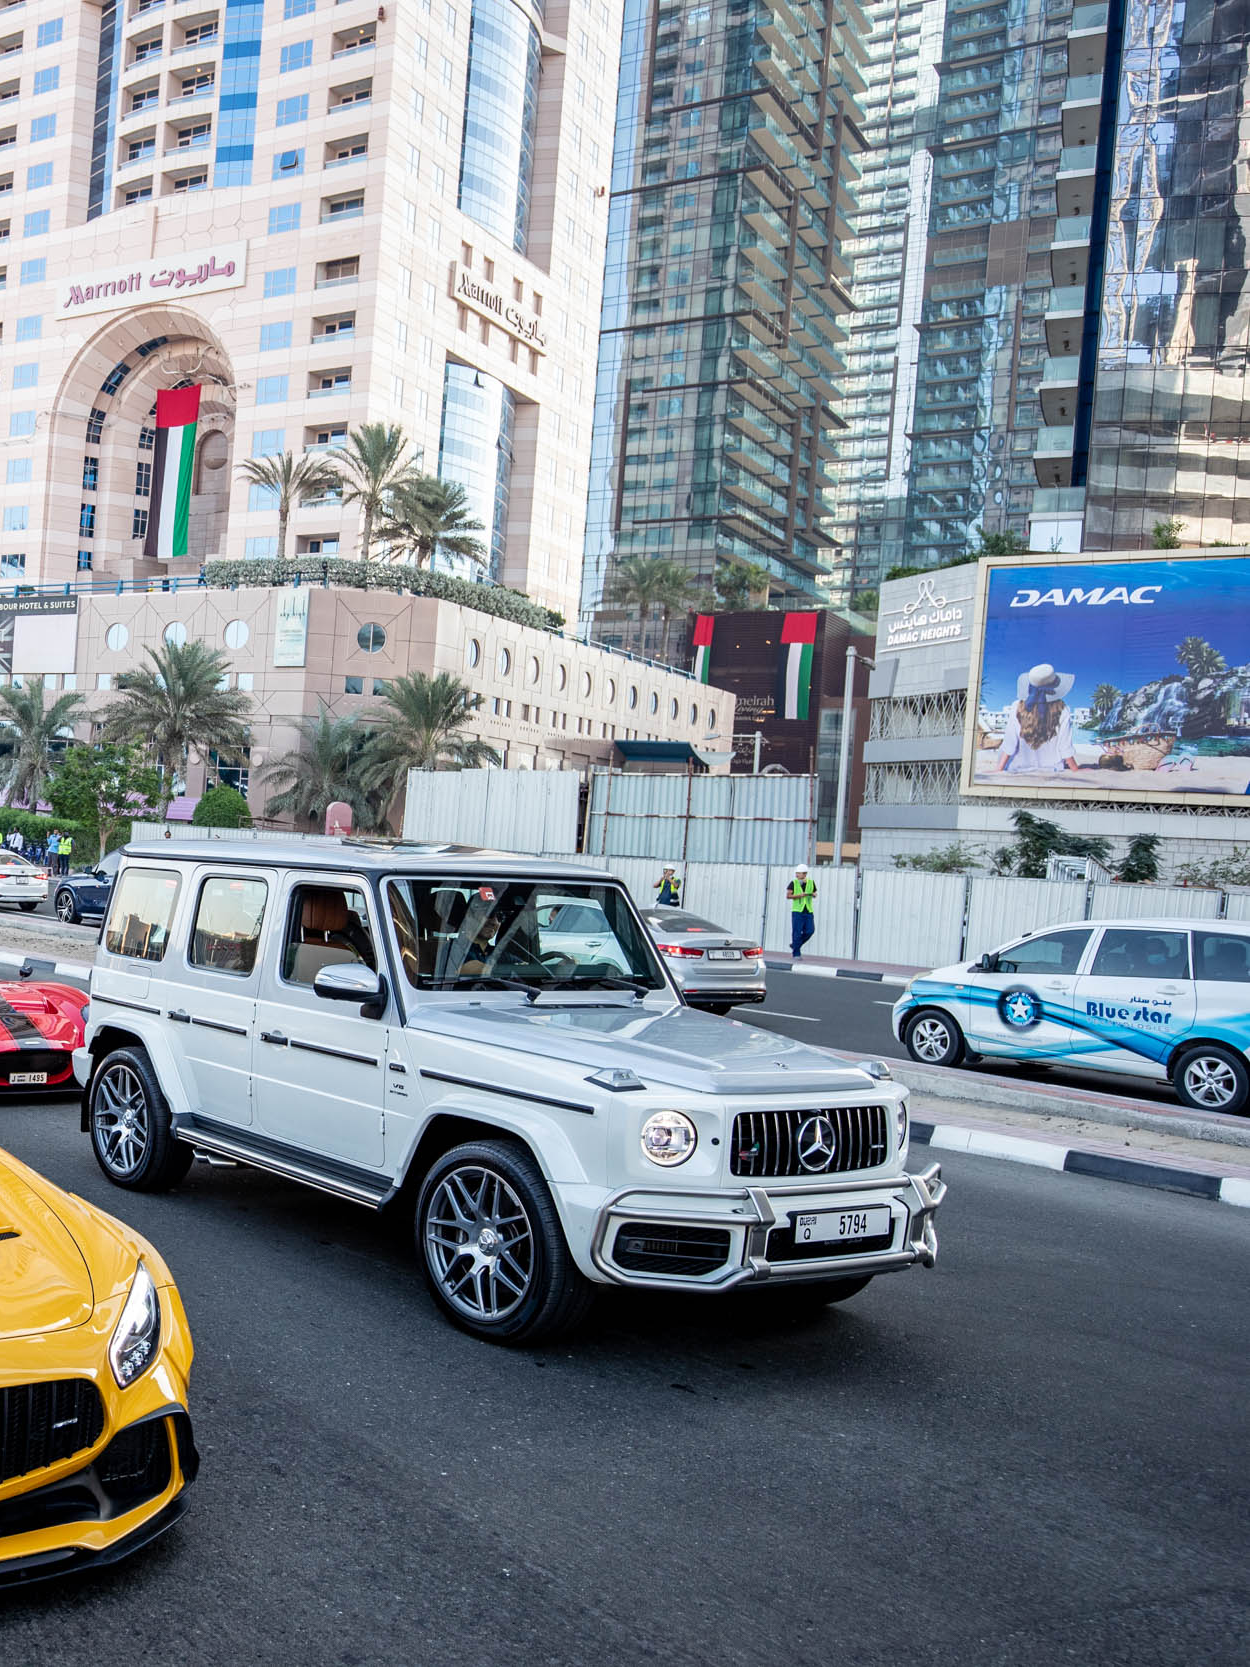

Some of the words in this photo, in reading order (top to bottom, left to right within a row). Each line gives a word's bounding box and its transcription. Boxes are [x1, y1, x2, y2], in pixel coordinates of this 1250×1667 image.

[149, 256, 235, 289] ماريوت
[63, 272, 142, 309] Marriott
[19, 601, 42, 610] HOTEL
[50, 600, 76, 609] SUITES
[1010, 585, 1163, 608] DAMAC
[929, 607, 963, 624] داماك
[887, 631, 919, 646] DAMAC
[920, 624, 961, 641] HEIGHTS
[1086, 1001, 1130, 1020] Blue
[1133, 1006, 1172, 1024] star
[804, 1228, 811, 1240] Q
[839, 1213, 867, 1235] 5794
